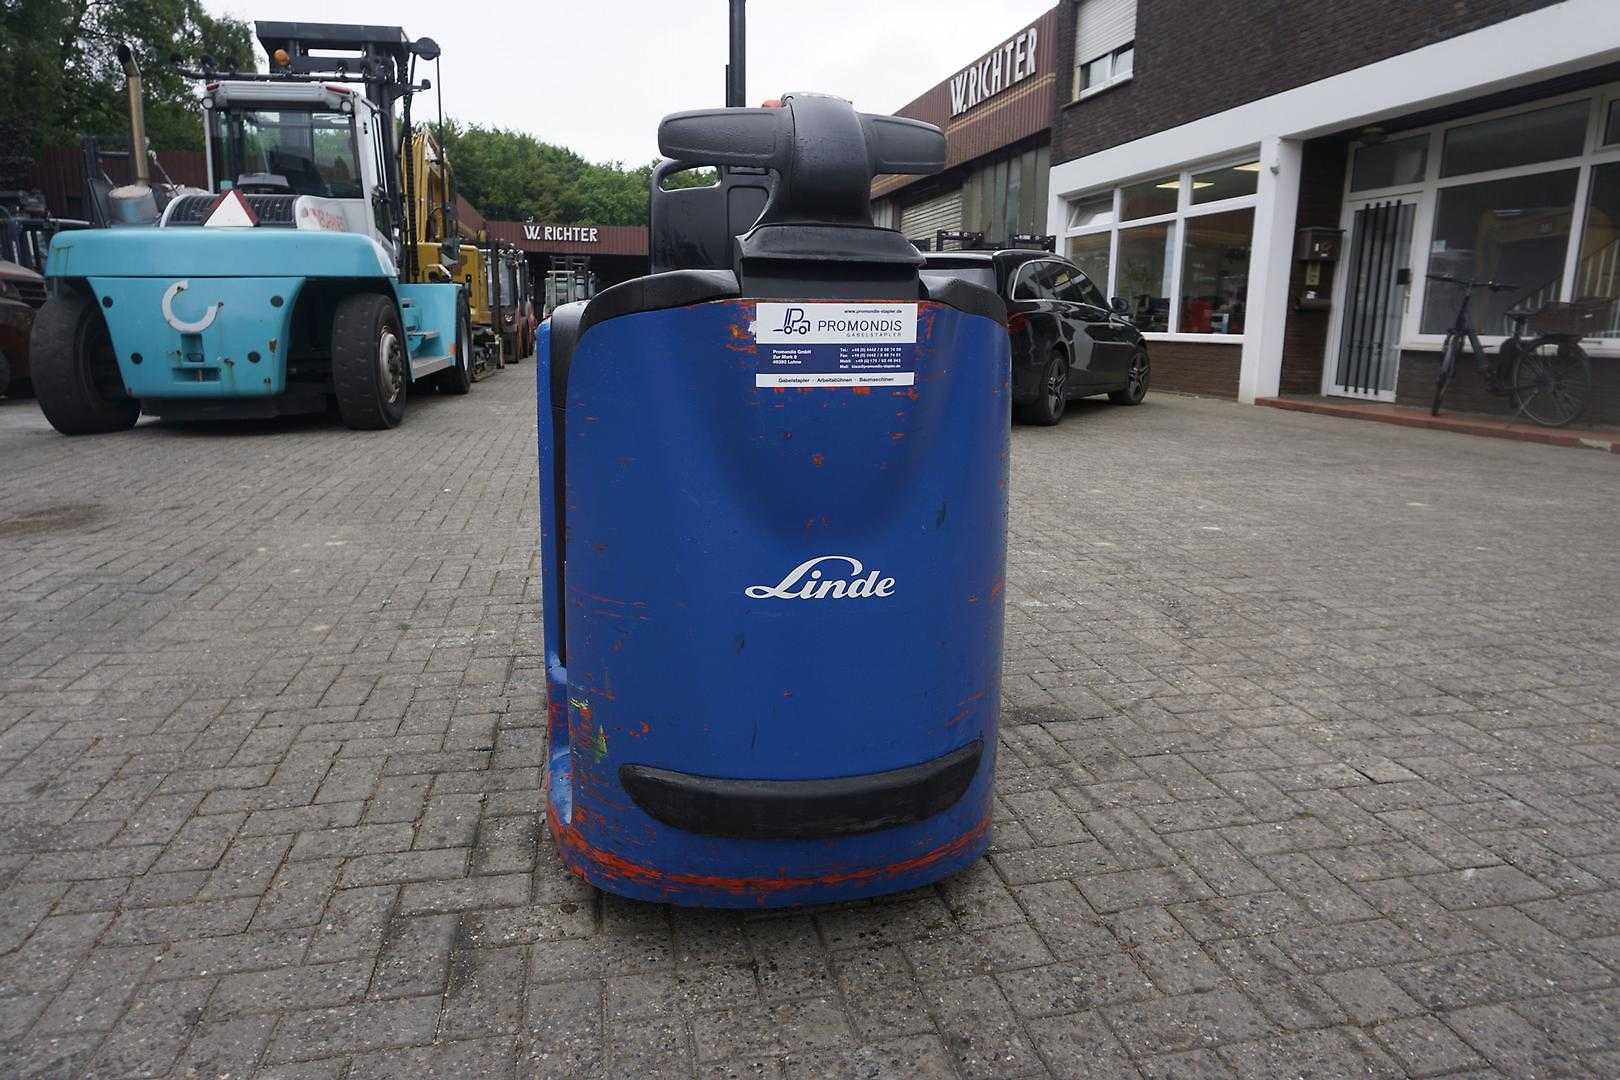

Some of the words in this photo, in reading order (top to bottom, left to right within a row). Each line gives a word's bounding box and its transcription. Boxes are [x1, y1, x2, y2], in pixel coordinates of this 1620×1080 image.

[950, 70, 969, 116] W.
[968, 27, 1038, 108] RICHTER
[523, 225, 541, 240] W.
[544, 226, 598, 242] RICHTER
[817, 320, 902, 332] PROMONDIS
[744, 555, 896, 600] Linde
